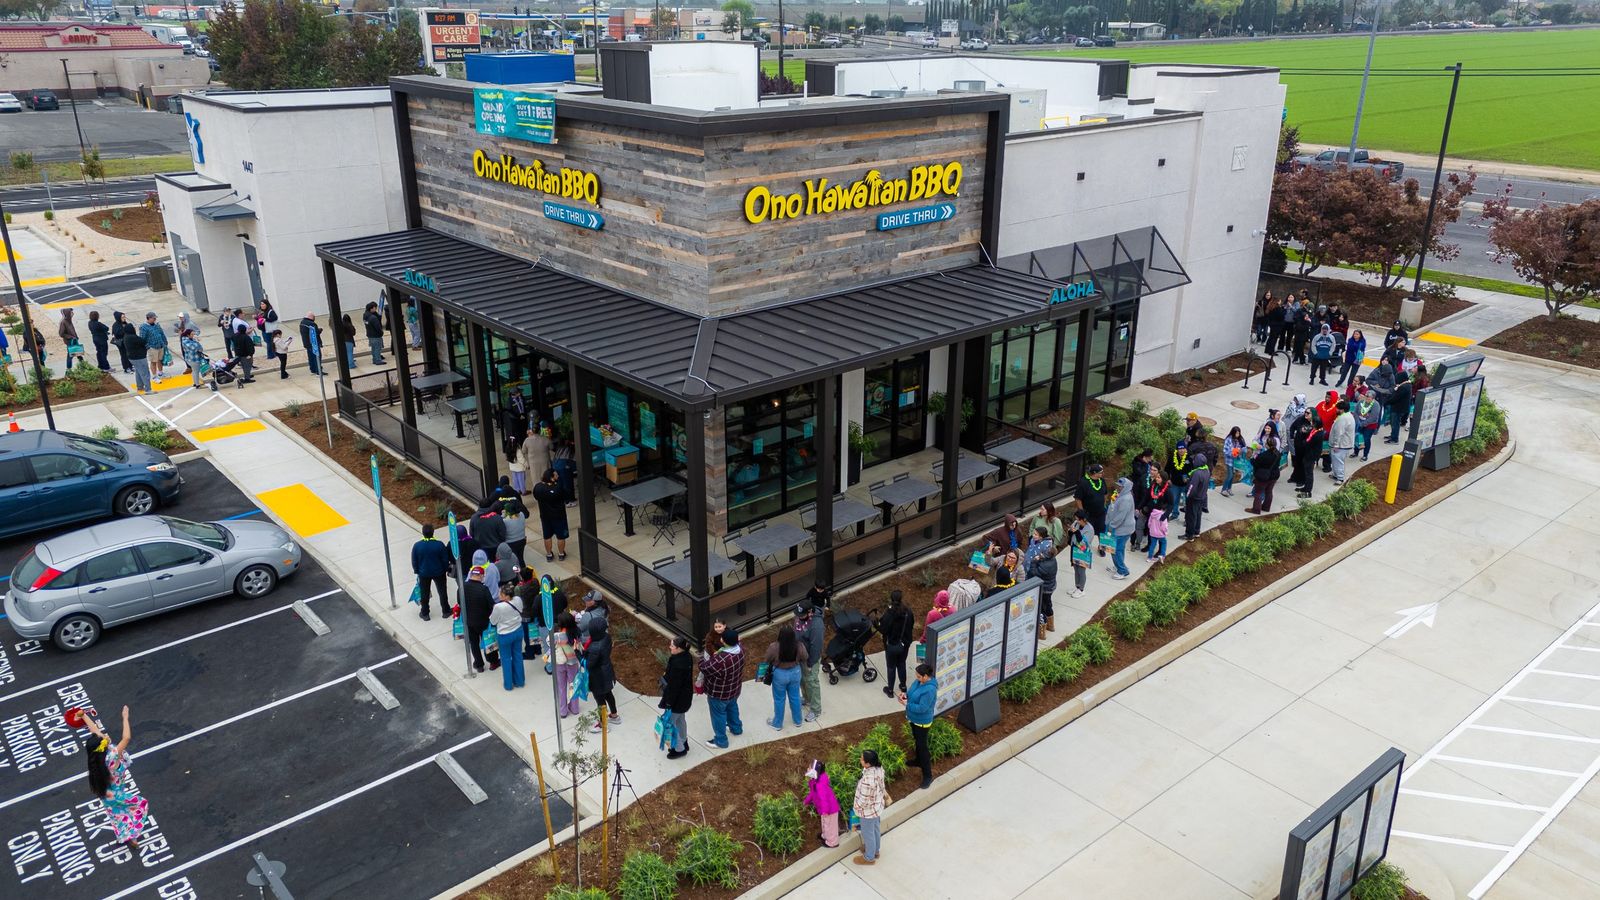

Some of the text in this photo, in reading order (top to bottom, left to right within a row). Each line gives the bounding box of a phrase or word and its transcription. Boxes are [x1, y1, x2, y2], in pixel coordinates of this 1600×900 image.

[435, 27, 473, 35] URGENT
[443, 35, 468, 43] CARE
[481, 111, 507, 124] OPENING
[473, 149, 598, 205] Ono Hawaiian BBQ
[745, 161, 963, 224] Ono Hawaiian BBQ
[544, 204, 585, 224] DRIVE THRU
[882, 209, 937, 228] DRIVE THRU
[404, 269, 436, 295] ALOHA
[1050, 280, 1095, 305] ALOHA
[15, 640, 44, 656] EV
[32, 704, 80, 756] PICK UP
[1, 714, 47, 773] PARKING
[75, 797, 115, 840] PICK
[95, 840, 133, 865] UP
[7, 830, 54, 884] ONLY
[40, 809, 96, 885] PARKING
